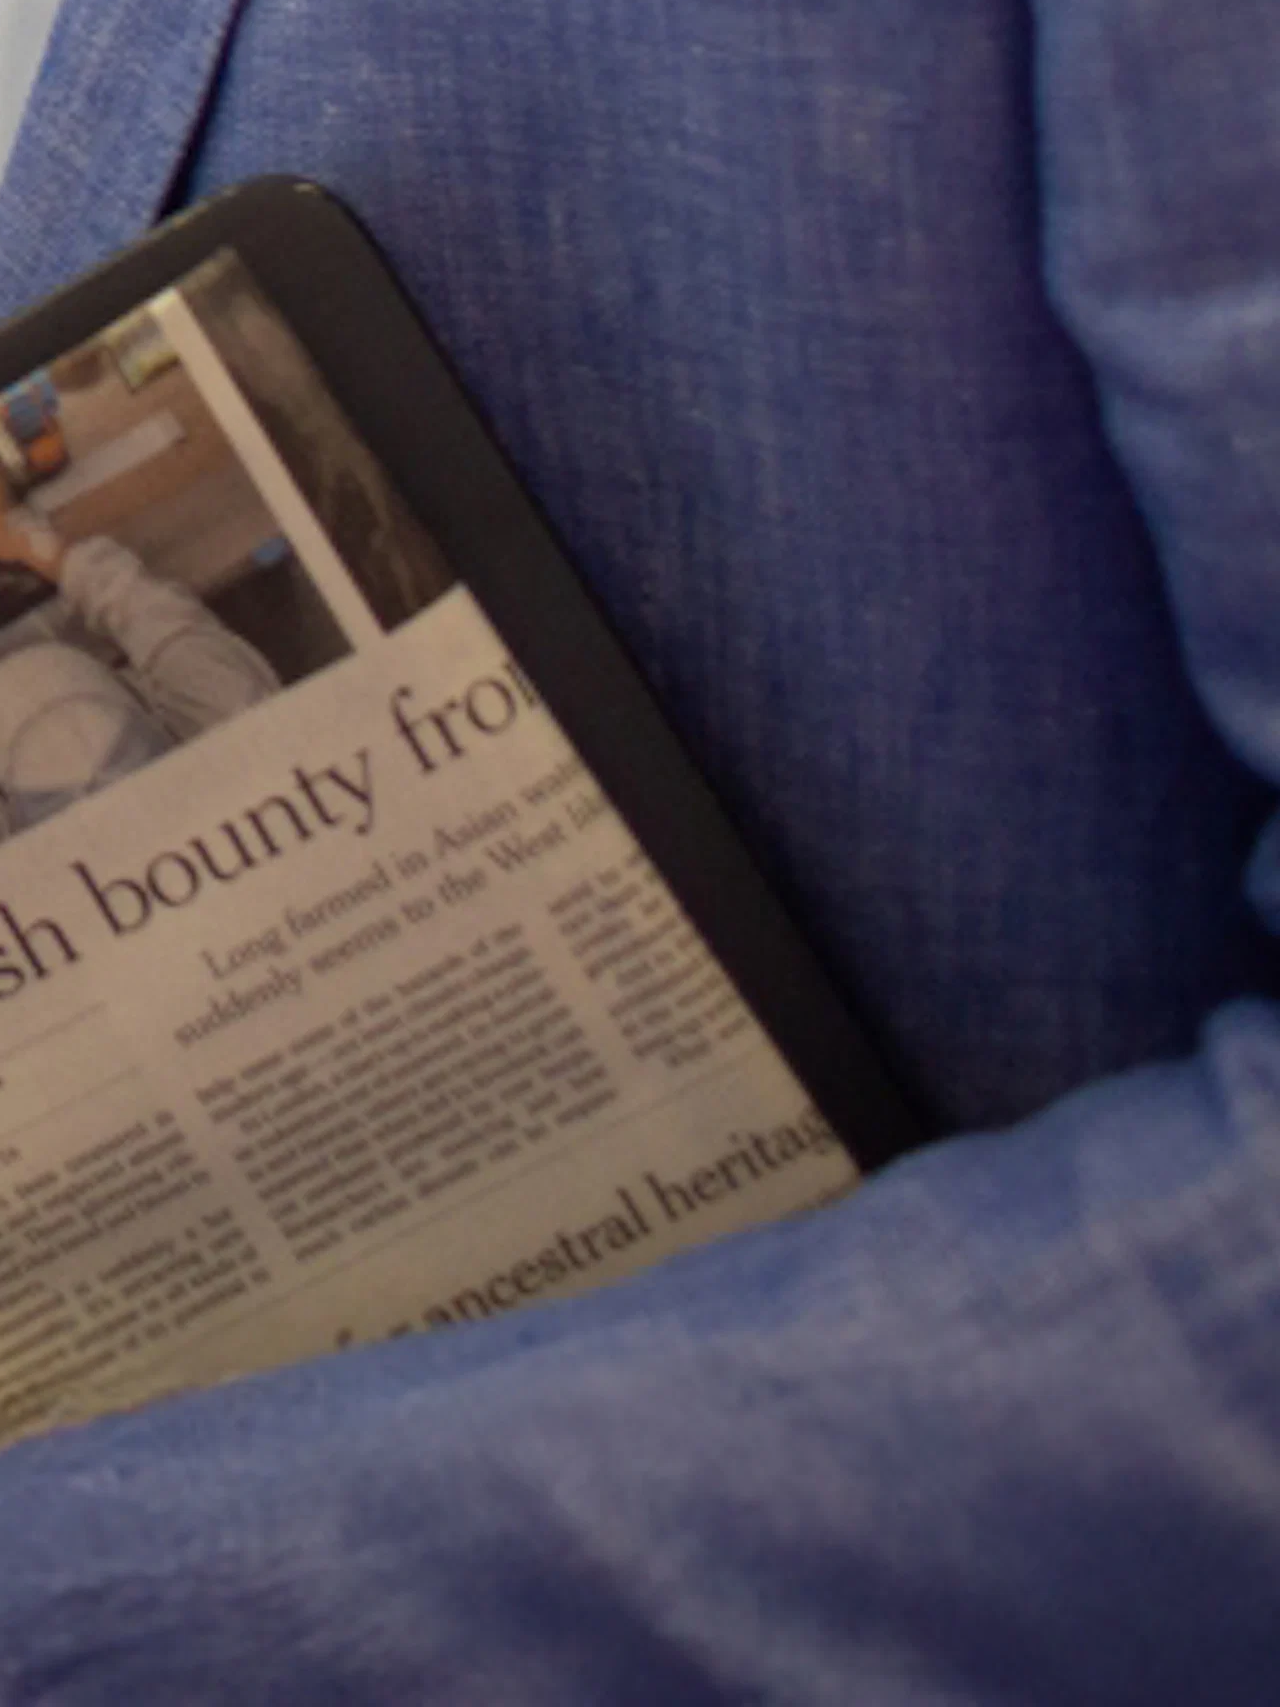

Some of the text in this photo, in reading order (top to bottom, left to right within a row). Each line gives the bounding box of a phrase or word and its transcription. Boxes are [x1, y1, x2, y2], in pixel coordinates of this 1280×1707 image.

[70, 750, 374, 936] bounty
[173, 964, 304, 1049] suddenly
[308, 916, 401, 975] seems
[398, 896, 436, 925] to
[435, 867, 488, 907] the
[483, 820, 568, 874] West
[200, 925, 292, 981] Long
[283, 859, 394, 939] farmed
[390, 849, 431, 881] in
[432, 801, 518, 860] Asian
